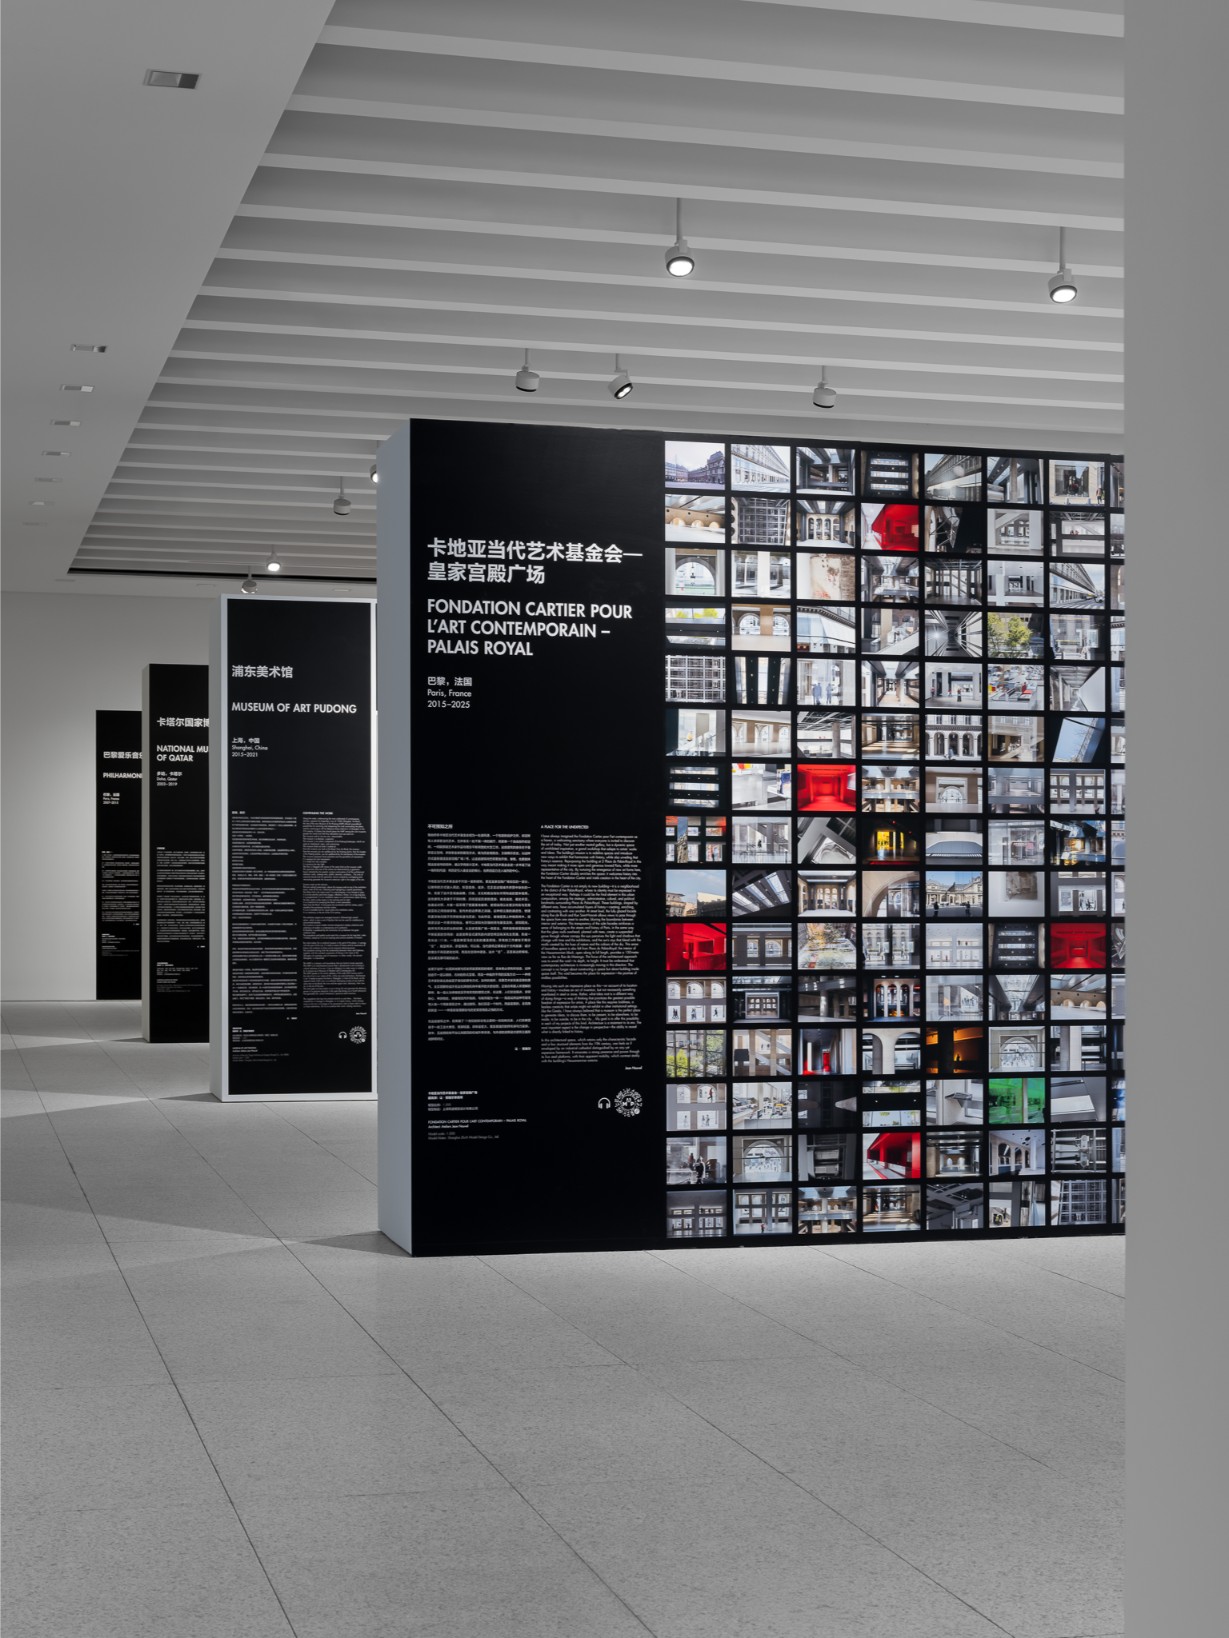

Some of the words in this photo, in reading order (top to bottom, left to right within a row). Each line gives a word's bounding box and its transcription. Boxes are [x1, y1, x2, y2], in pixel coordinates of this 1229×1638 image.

[427, 561, 546, 584] 皇家宫殿广场
[428, 599, 520, 615] FONDATION
[525, 602, 586, 617] CARTIER
[591, 604, 632, 619] POUR
[471, 620, 596, 638] CONTEMPORAIN
[428, 639, 479, 654] PALAIS
[484, 641, 533, 656] ROYAL
[232, 665, 293, 678] 浦东美术馆
[428, 689, 446, 697] Paris,
[449, 689, 471, 697] France
[232, 702, 274, 712] MUSEUM
[277, 703, 290, 712] OF
[293, 703, 311, 712] ART
[314, 704, 357, 714] PUDONG
[169, 754, 193, 762] QATAR
